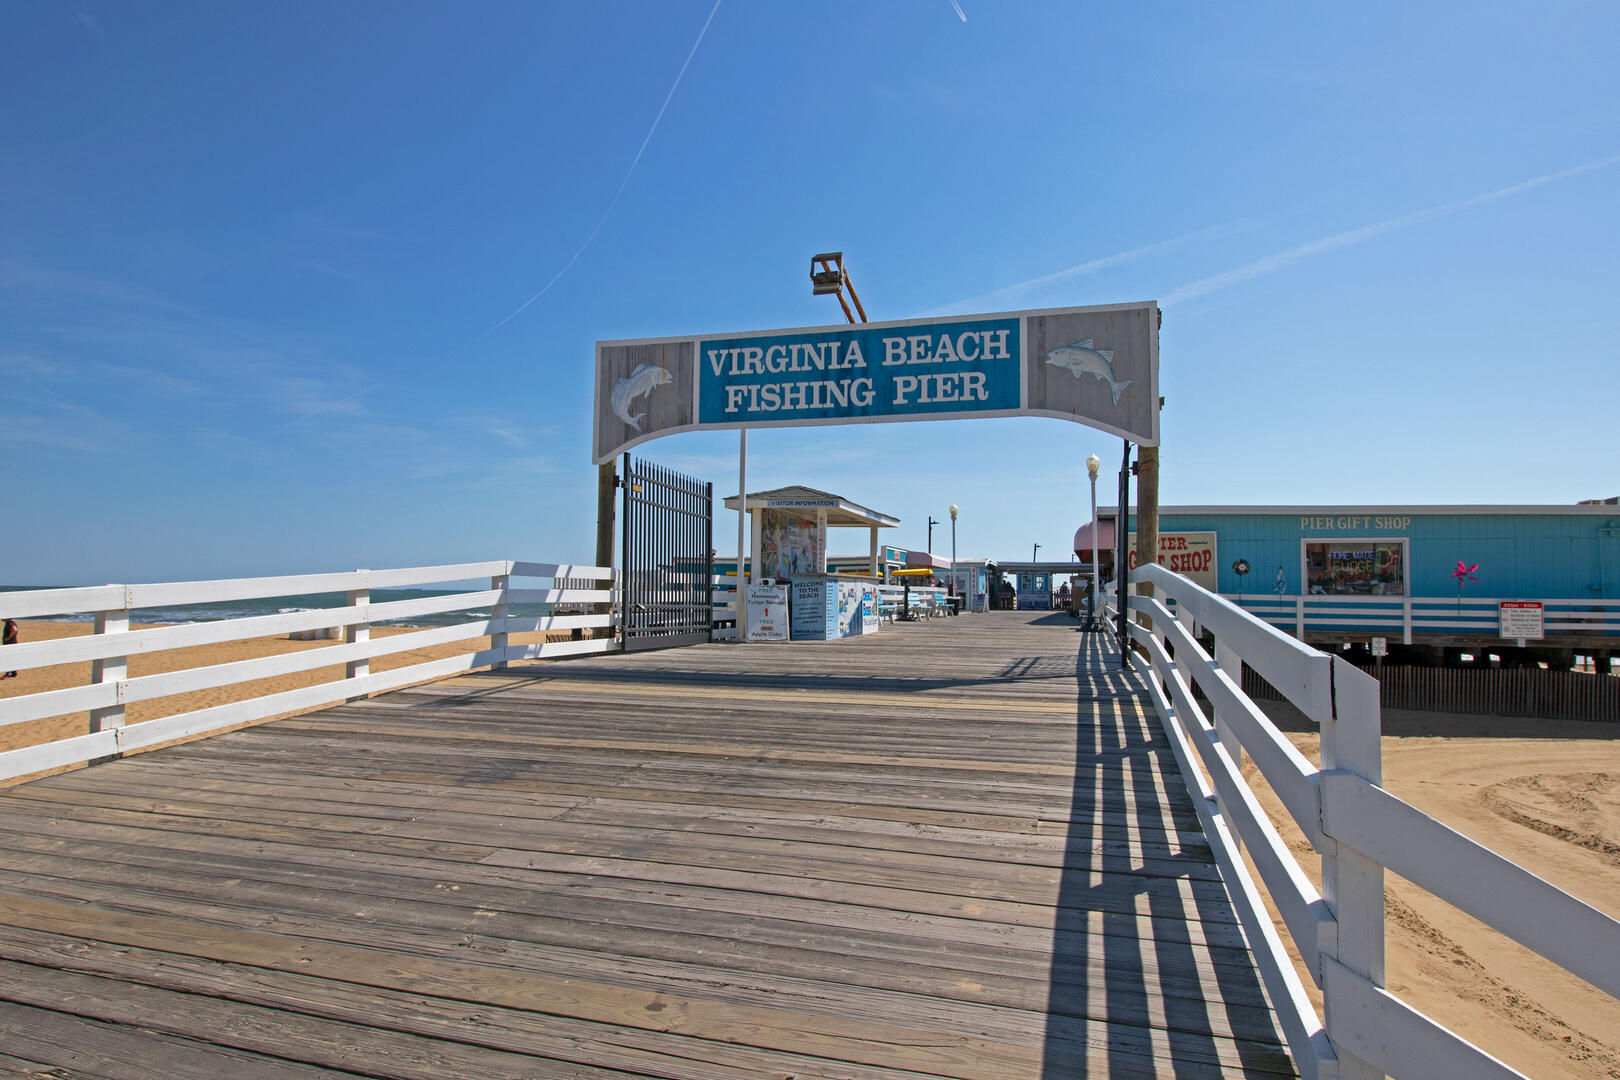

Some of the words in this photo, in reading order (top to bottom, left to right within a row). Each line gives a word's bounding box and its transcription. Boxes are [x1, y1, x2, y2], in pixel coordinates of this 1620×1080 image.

[707, 340, 868, 377] VIRGINIA
[882, 329, 1011, 366] BEACH
[724, 377, 877, 414] FISHING
[892, 370, 990, 405] PIER
[1300, 517, 1334, 530] PIER
[1337, 516, 1371, 530] GIFT
[1375, 516, 1411, 530] SHOP
[1158, 537, 1188, 551] IER
[1170, 549, 1212, 572] SHOP
[1329, 551, 1350, 560] HOME
[1352, 551, 1376, 560] MADE
[1332, 560, 1374, 572] FUDGE
